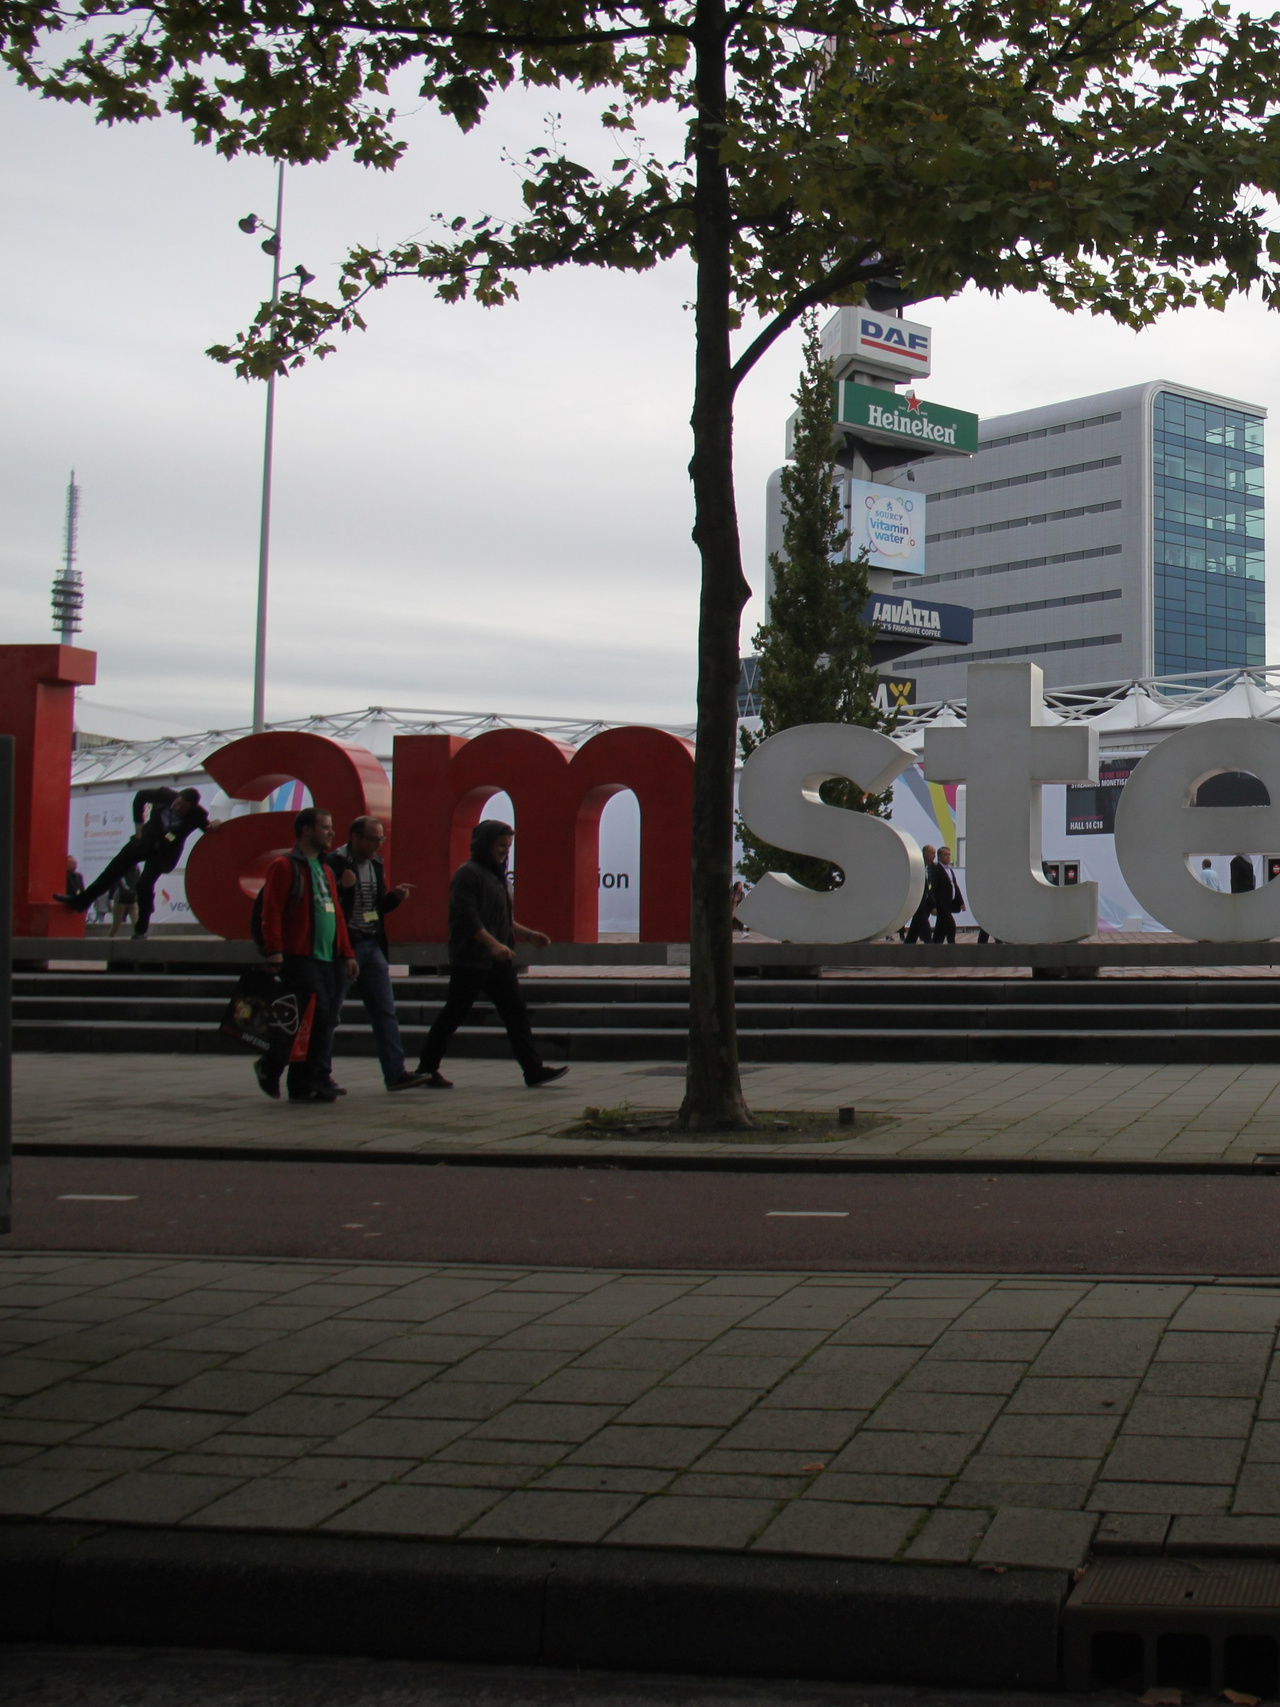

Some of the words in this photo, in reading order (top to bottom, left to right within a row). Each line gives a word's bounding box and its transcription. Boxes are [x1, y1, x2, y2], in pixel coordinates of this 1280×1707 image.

[861, 319, 928, 349] DAF
[874, 510, 904, 521] SOURCY
[874, 531, 905, 544] water
[873, 600, 941, 630] LAVAZZA
[892, 624, 920, 635] FAVOURITE
[921, 628, 941, 637] COFFEE
[1070, 821, 1085, 830] HALL
[1086, 821, 1092, 830] 14
